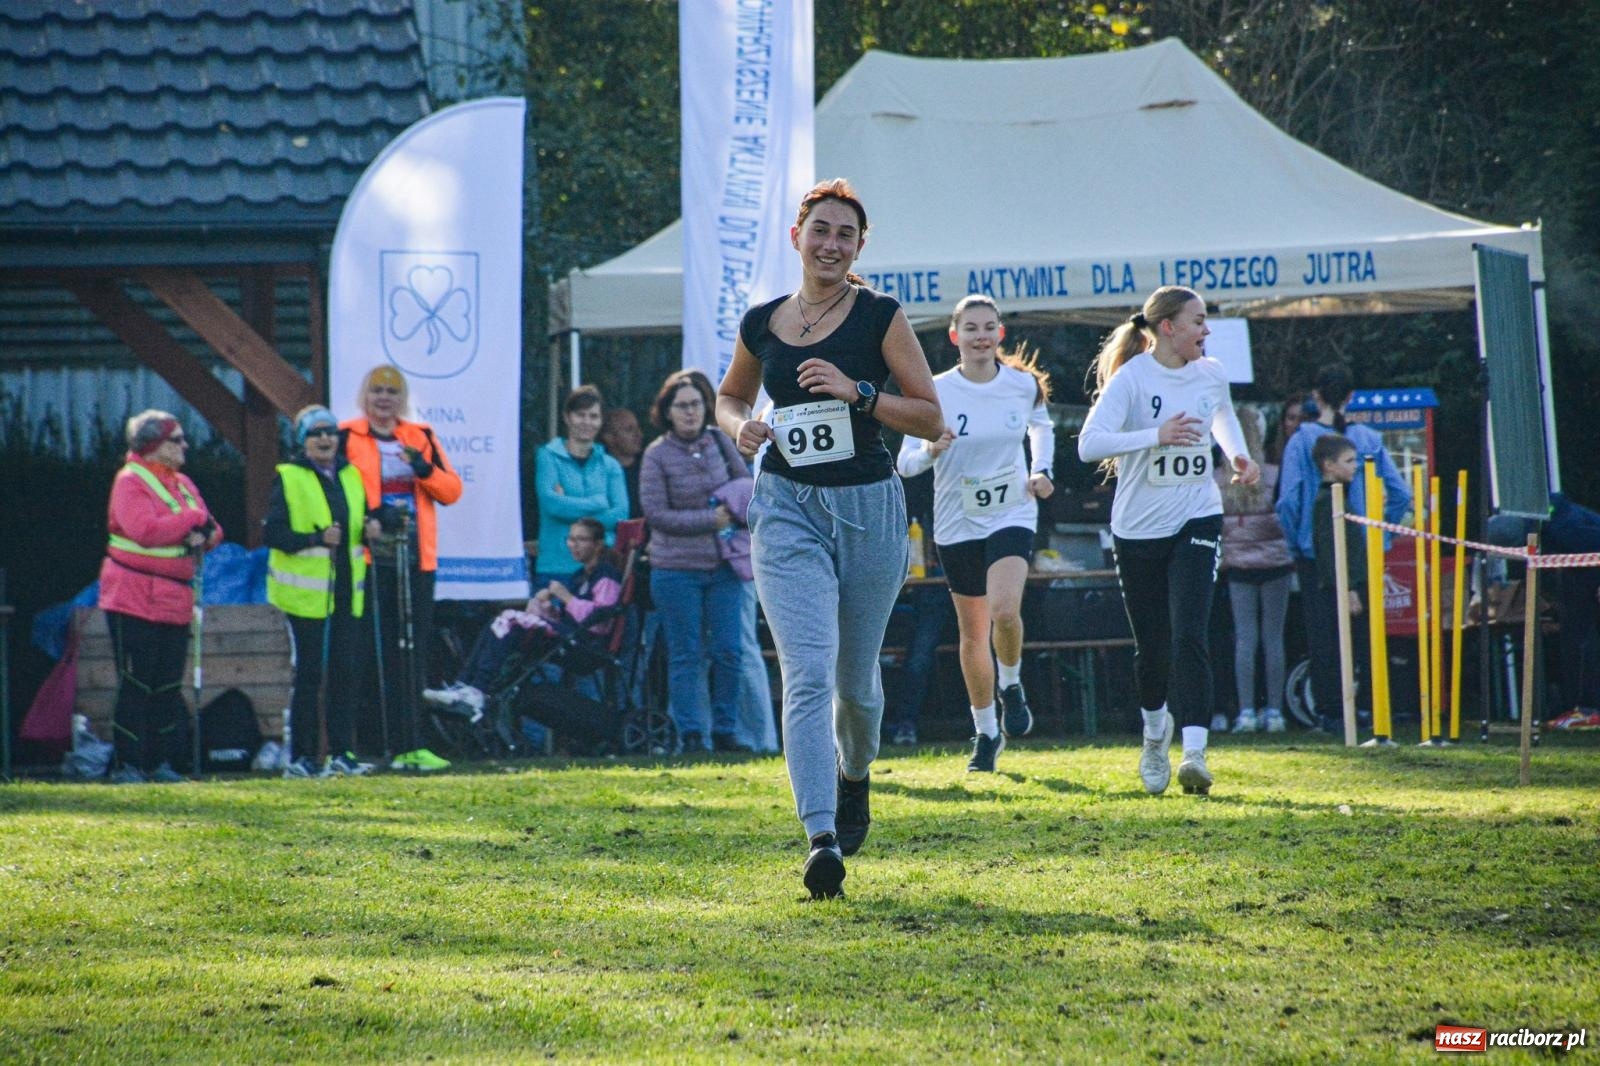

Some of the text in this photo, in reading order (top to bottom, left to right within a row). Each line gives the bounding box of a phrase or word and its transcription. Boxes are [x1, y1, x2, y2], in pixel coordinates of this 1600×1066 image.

[867, 250, 1377, 303] ZENIE AKTYWNI DLA LEPSZEGO JUTRA
[417, 407, 466, 424] MINA
[1151, 395, 1162, 419] 9
[957, 413, 969, 436] 2
[787, 424, 835, 455] 98
[1153, 455, 1207, 476] 109
[975, 484, 1009, 507] 97
